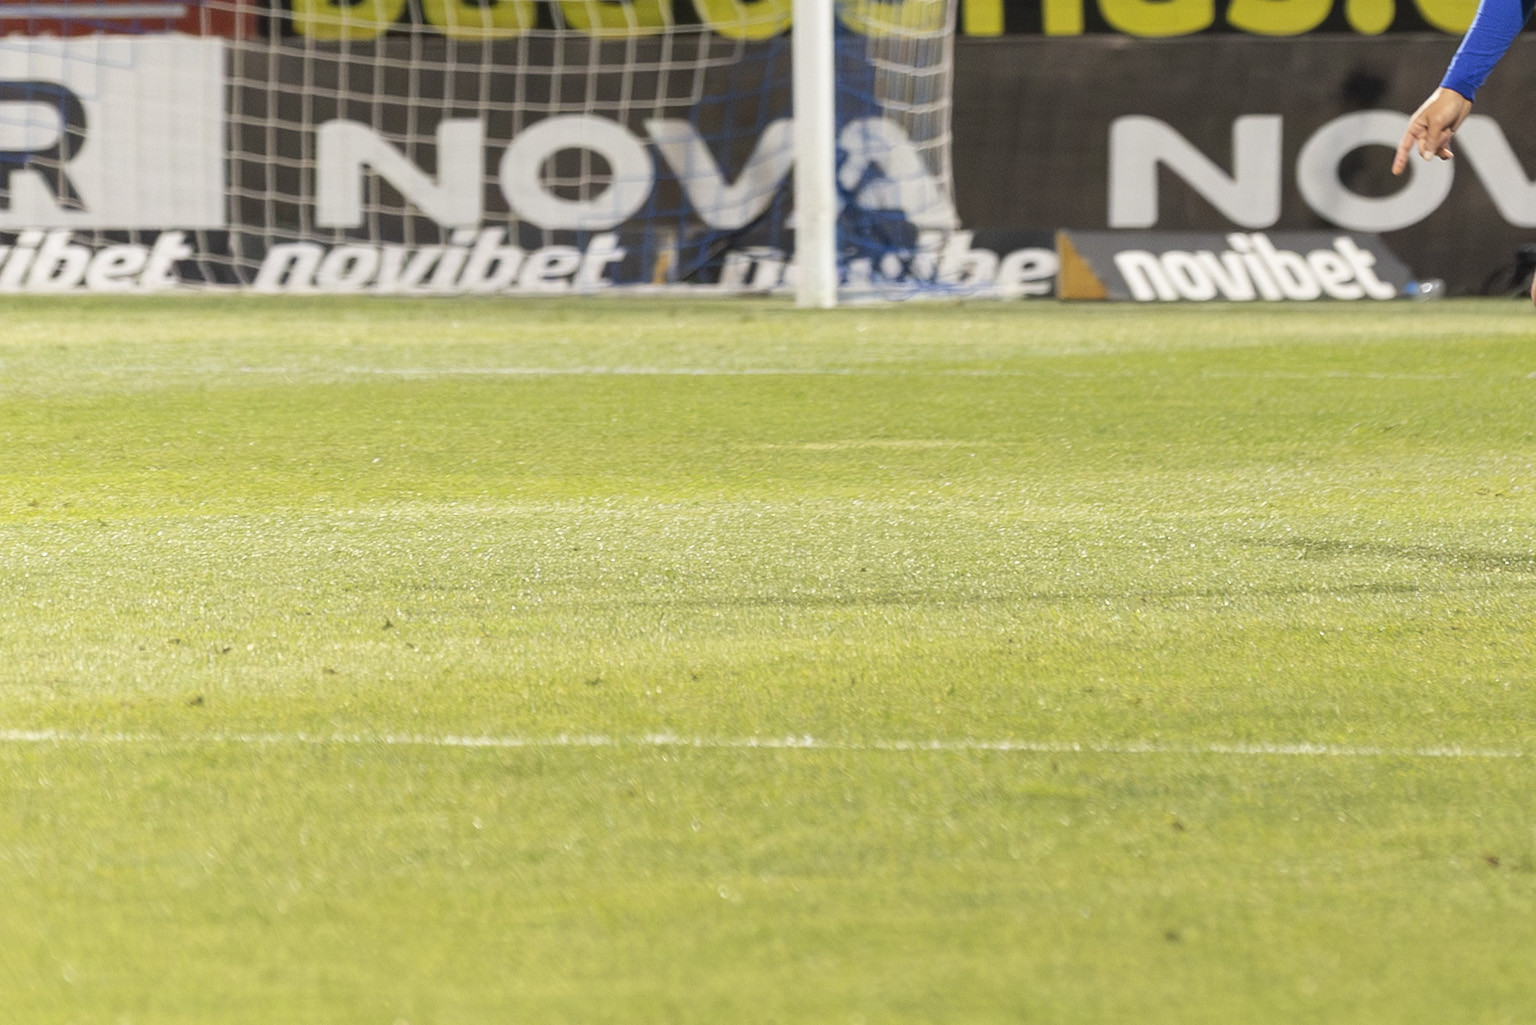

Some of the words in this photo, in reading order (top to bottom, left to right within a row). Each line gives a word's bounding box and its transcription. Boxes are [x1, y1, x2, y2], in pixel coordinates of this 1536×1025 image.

[315, 113, 961, 230] NOVA
[0, 228, 194, 293] ibet
[253, 228, 625, 293] novibet
[1113, 231, 1398, 301] novibet
